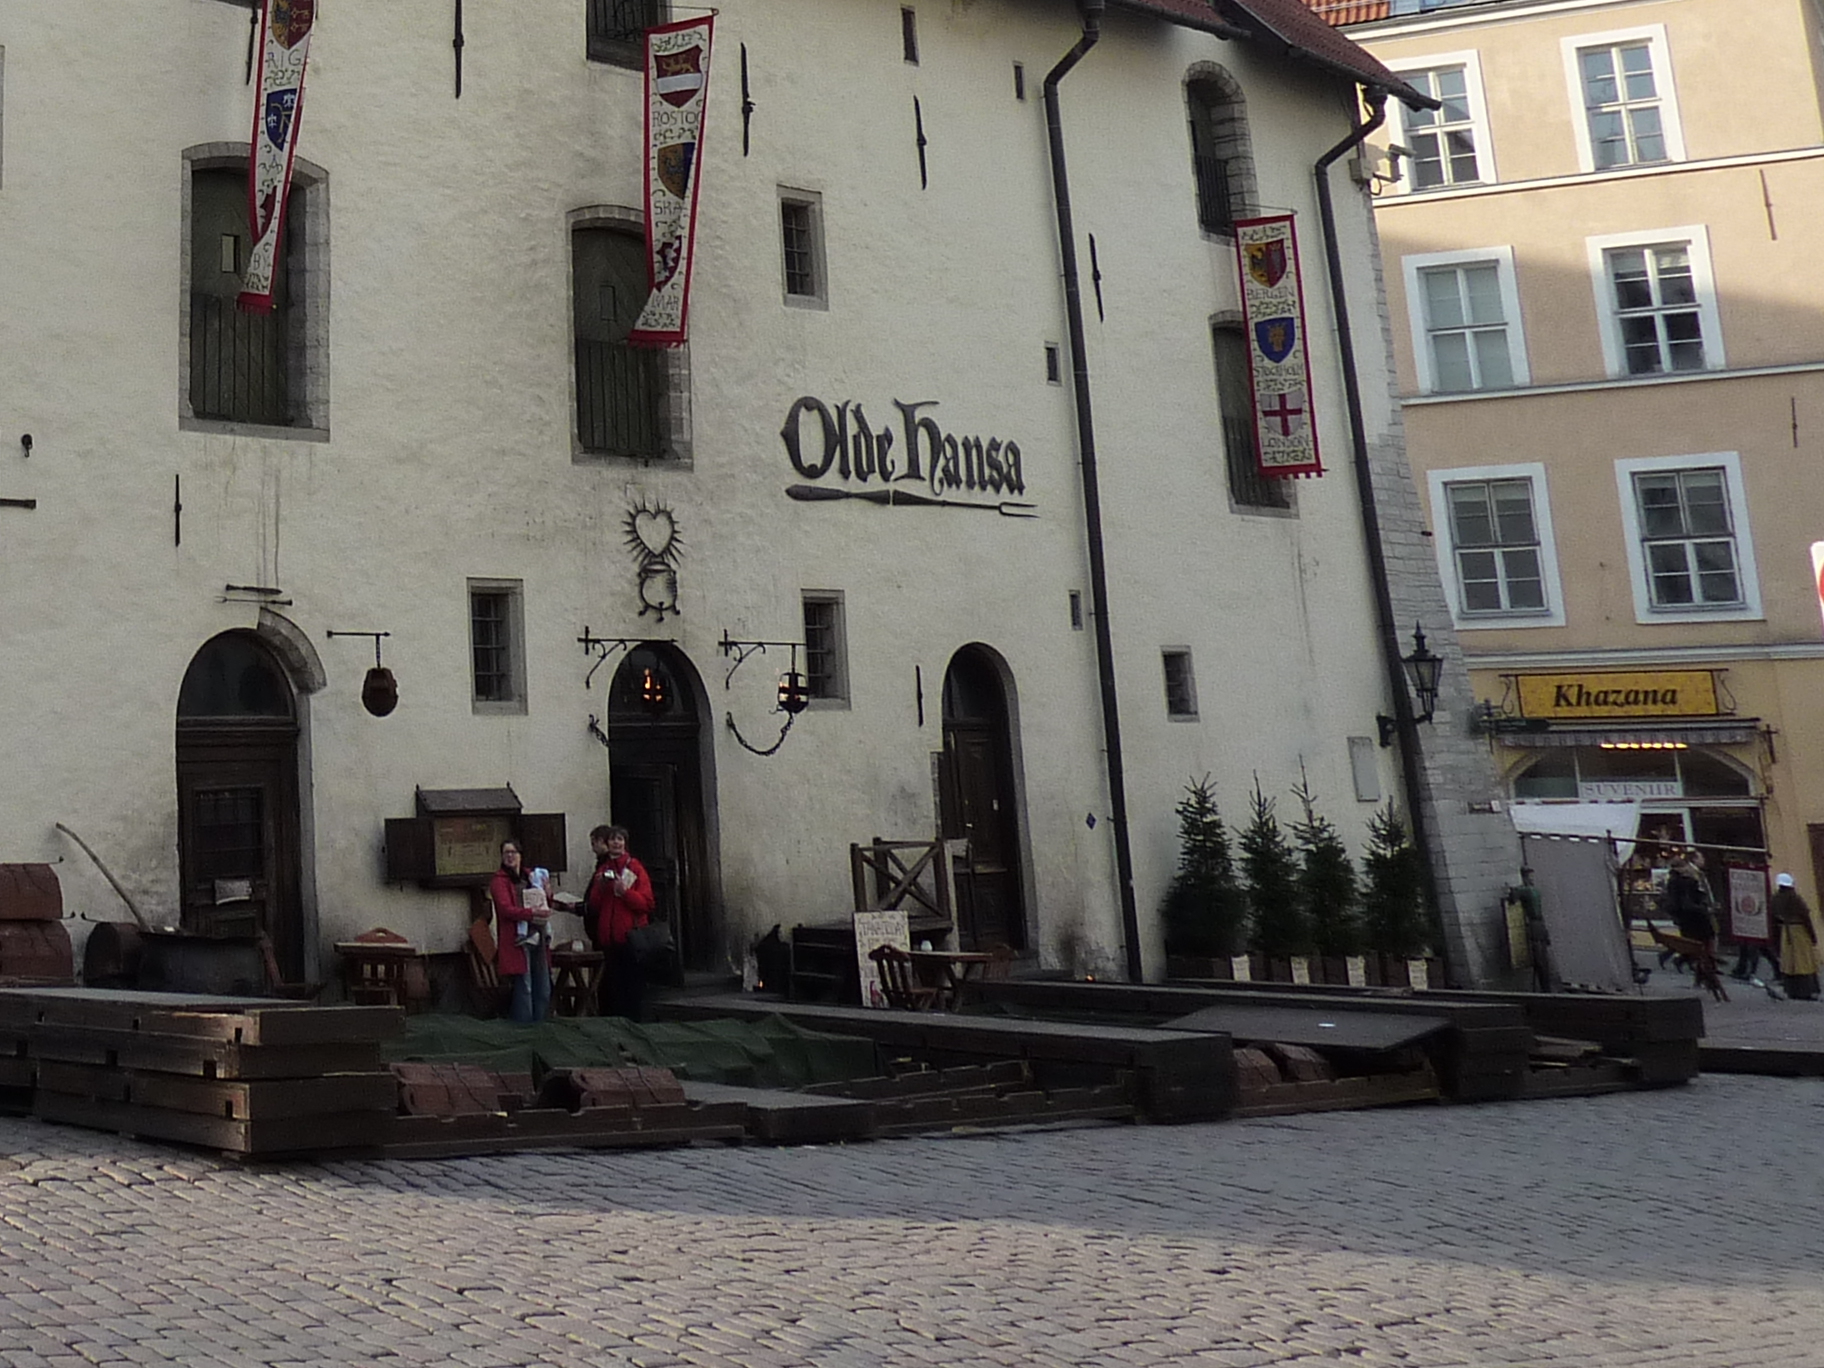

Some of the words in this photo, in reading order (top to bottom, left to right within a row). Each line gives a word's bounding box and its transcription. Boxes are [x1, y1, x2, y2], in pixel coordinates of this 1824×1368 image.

[779, 395, 896, 484] Olde
[1261, 433, 1311, 449] LONDON
[1553, 683, 1678, 708] Khazana
[1584, 783, 1677, 797] SUVENIIR
